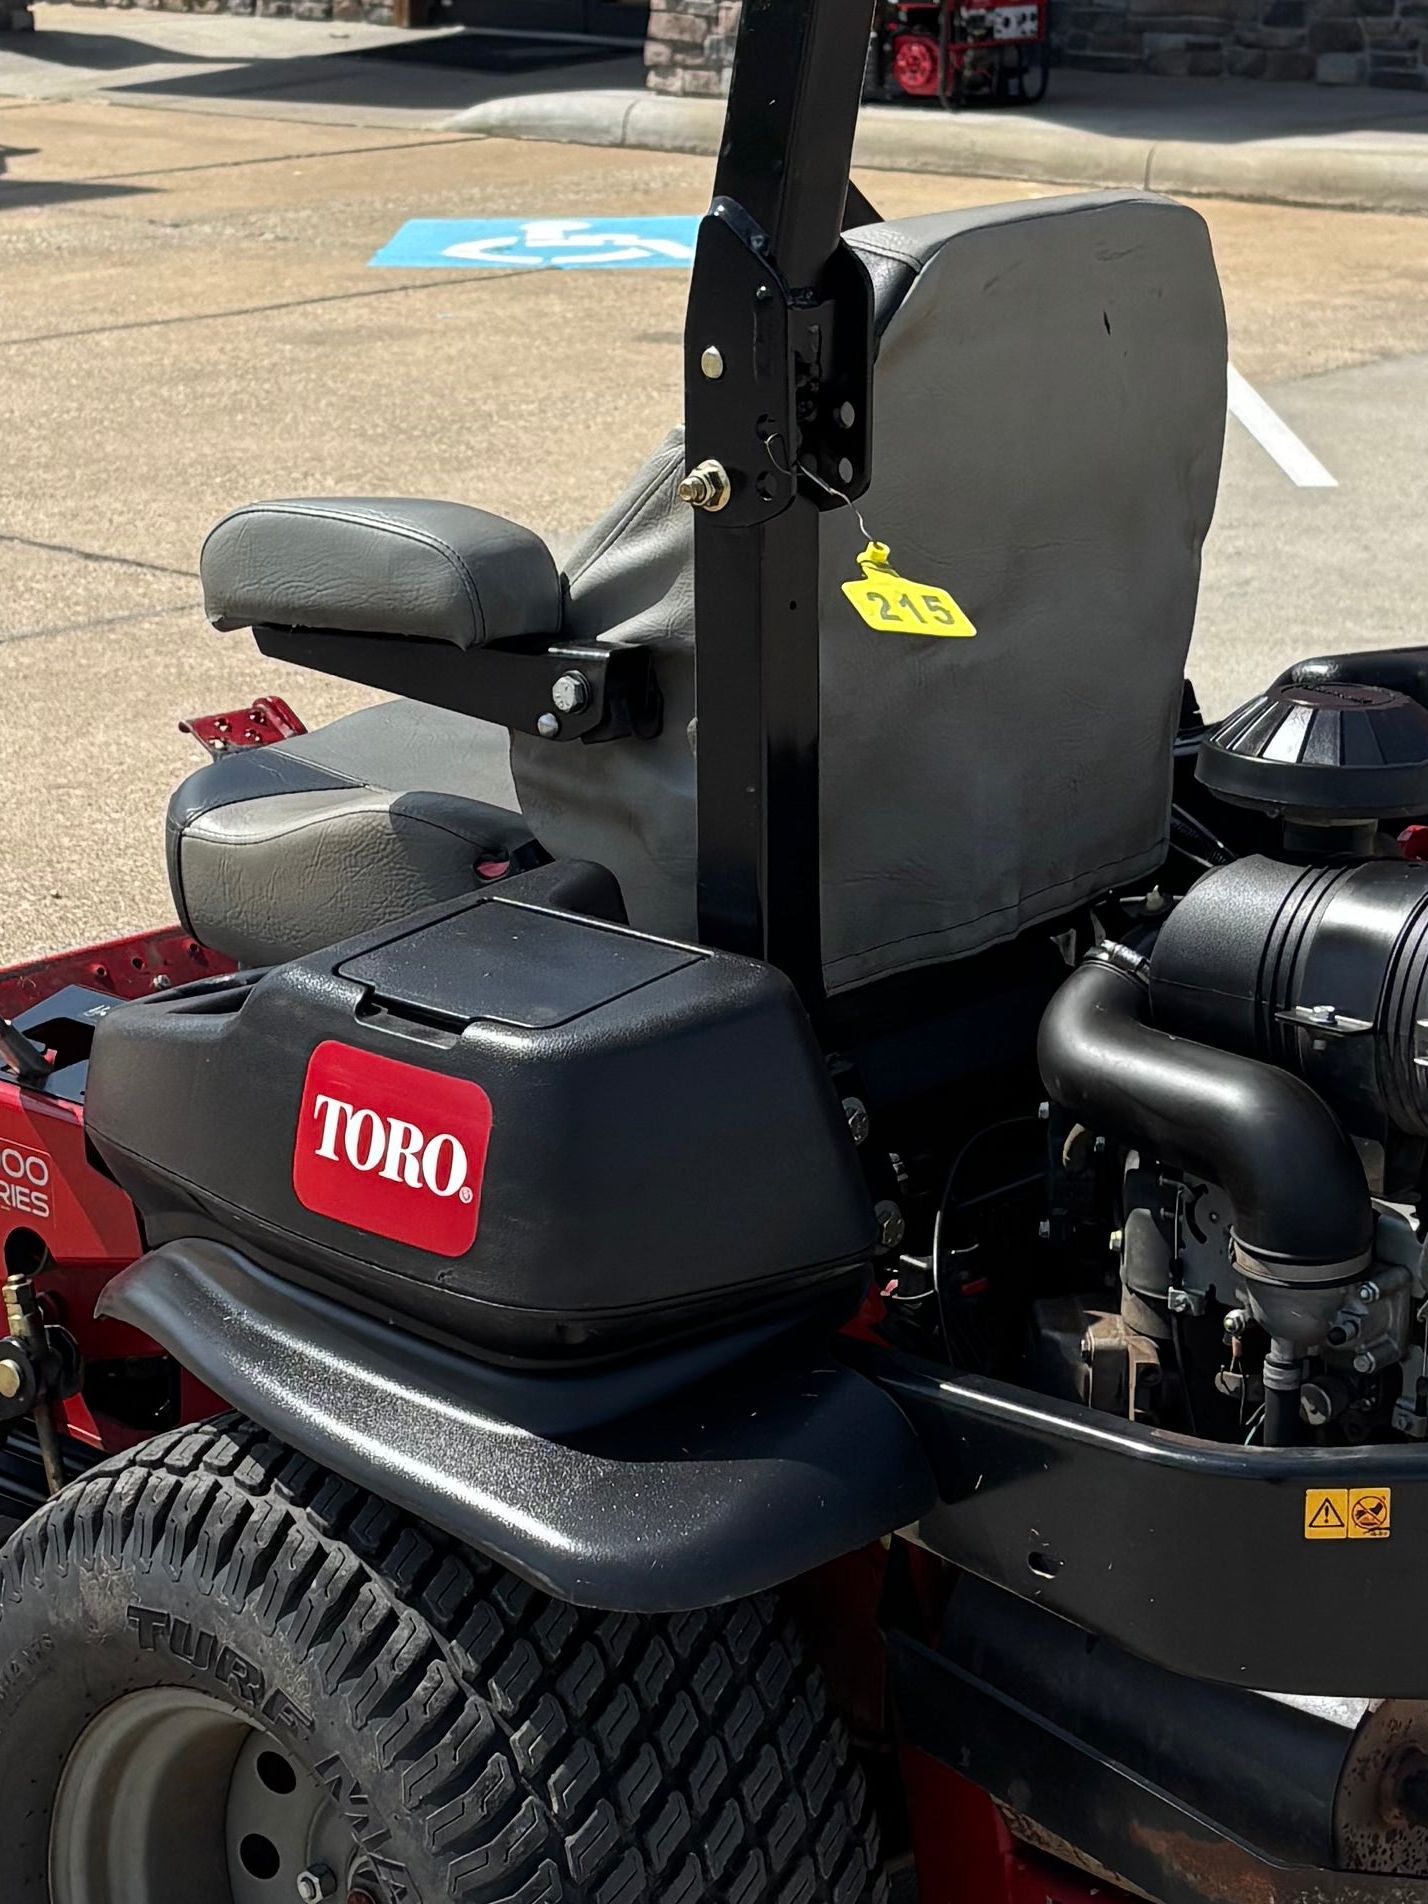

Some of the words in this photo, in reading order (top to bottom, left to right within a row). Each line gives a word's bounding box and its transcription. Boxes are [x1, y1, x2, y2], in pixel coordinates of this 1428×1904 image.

[866, 592, 955, 625] 215
[313, 1094, 468, 1197] TORO
[126, 1604, 316, 1741] TURF
